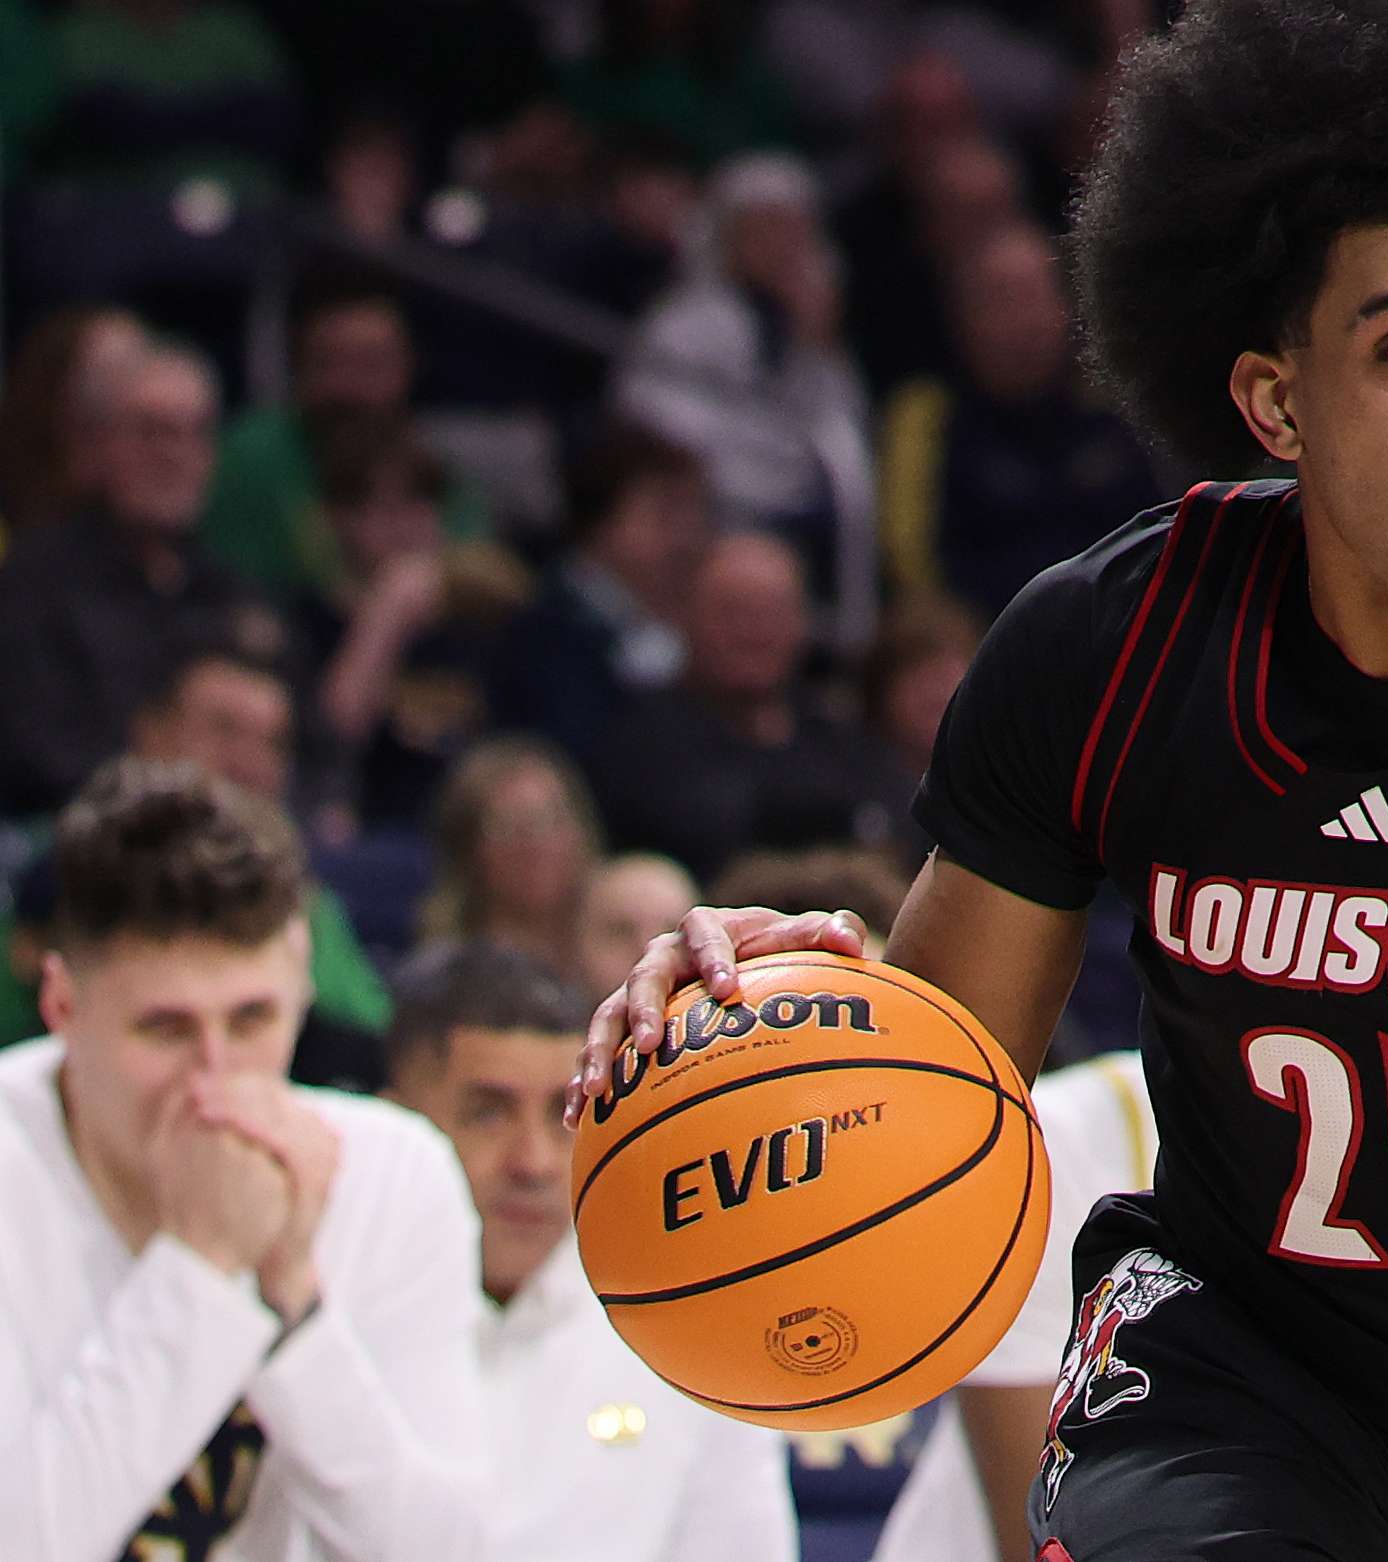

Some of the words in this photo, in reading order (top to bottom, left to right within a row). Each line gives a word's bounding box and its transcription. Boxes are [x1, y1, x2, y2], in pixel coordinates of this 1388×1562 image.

[650, 1060, 700, 1090] INDOOR
[705, 1046, 746, 1062] GAME
[752, 1037, 791, 1050] BALL
[663, 1116, 828, 1232] EVO
[830, 1102, 887, 1134] NXT
